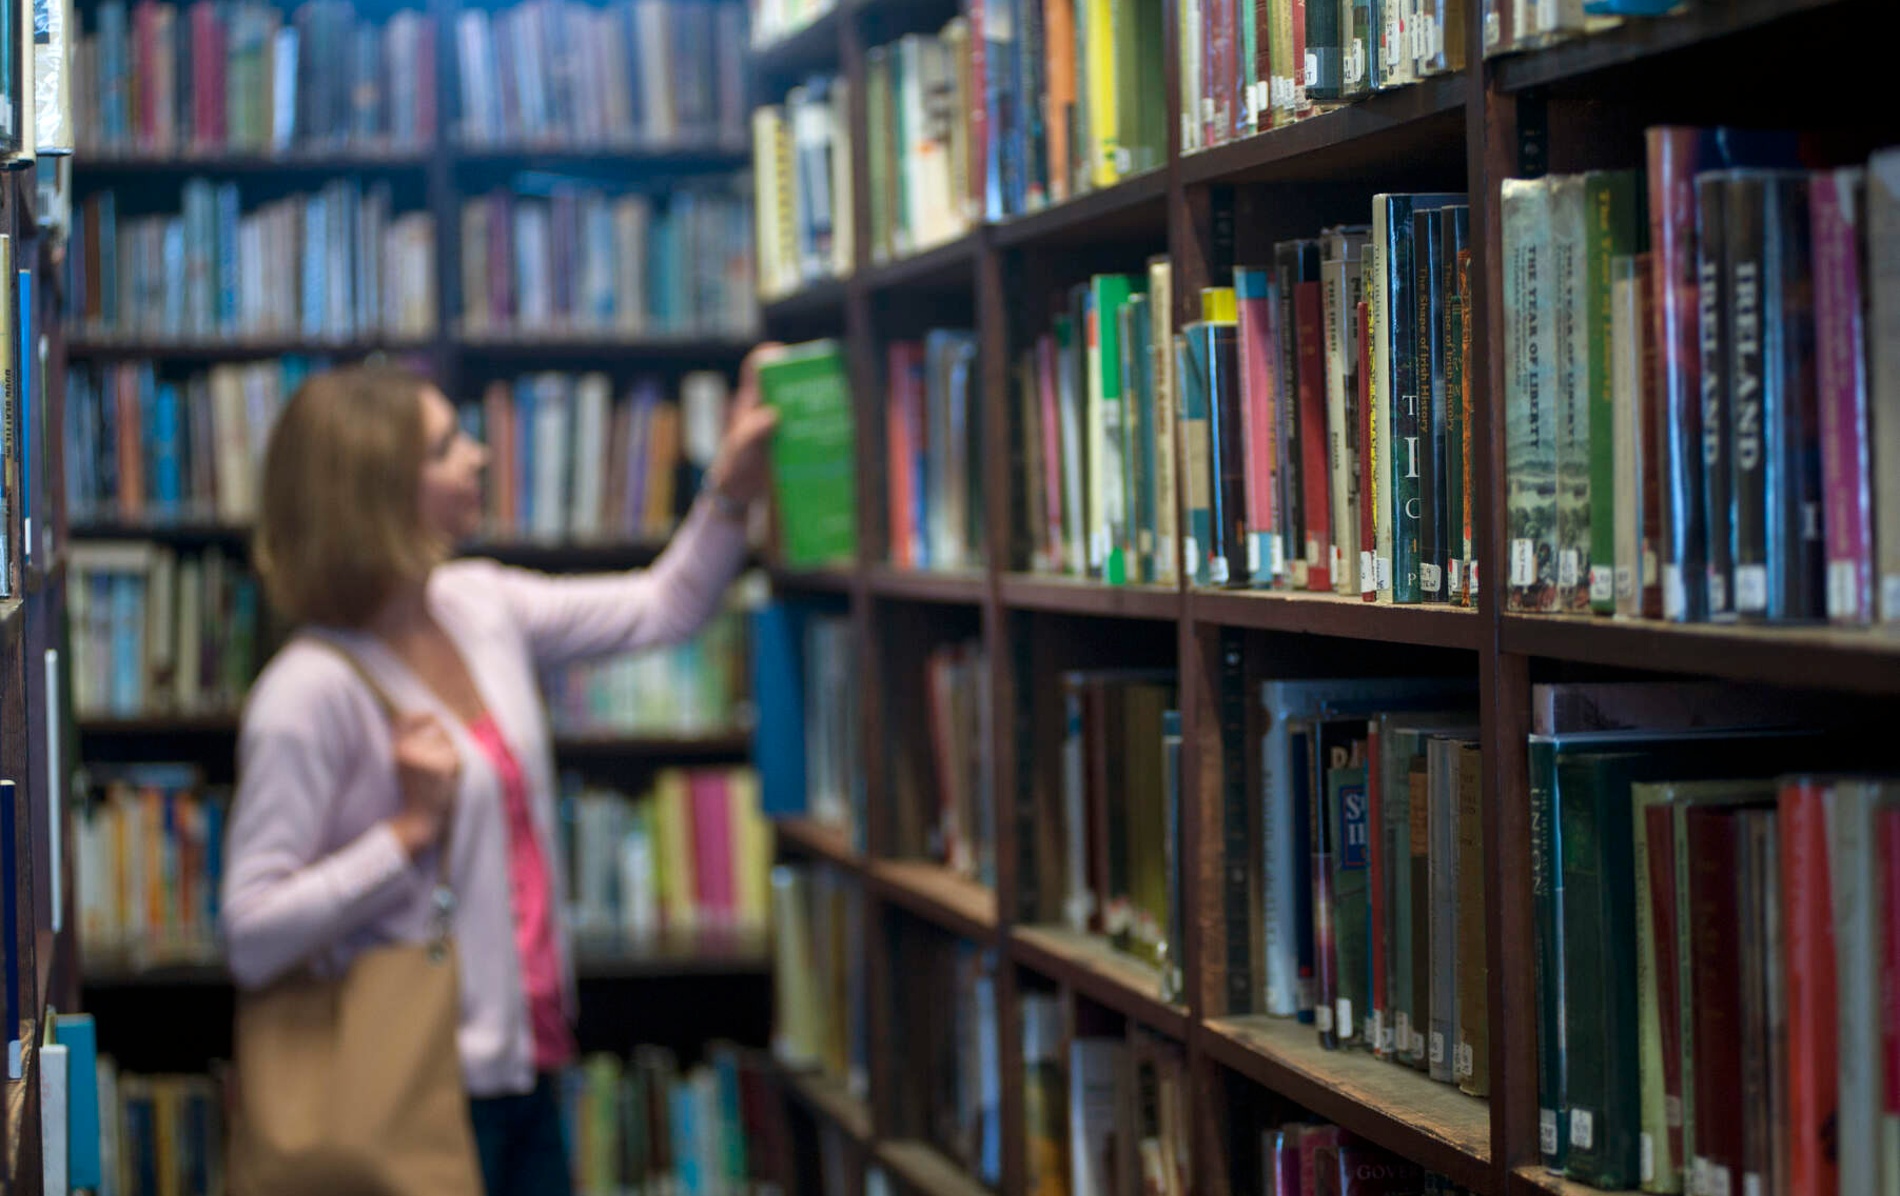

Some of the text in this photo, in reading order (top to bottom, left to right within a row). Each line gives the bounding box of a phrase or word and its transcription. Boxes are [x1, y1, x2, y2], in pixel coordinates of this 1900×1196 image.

[1444, 263, 1452, 288] The
[1418, 266, 1431, 433] The Shape of Irish History
[1446, 351, 1454, 380] Irish
[1529, 245, 1540, 449] THE YEAR OF LIBERTY
[1737, 262, 1760, 471] IRELAND
[1446, 384, 1455, 432] History
[1531, 788, 1542, 896] UNION
